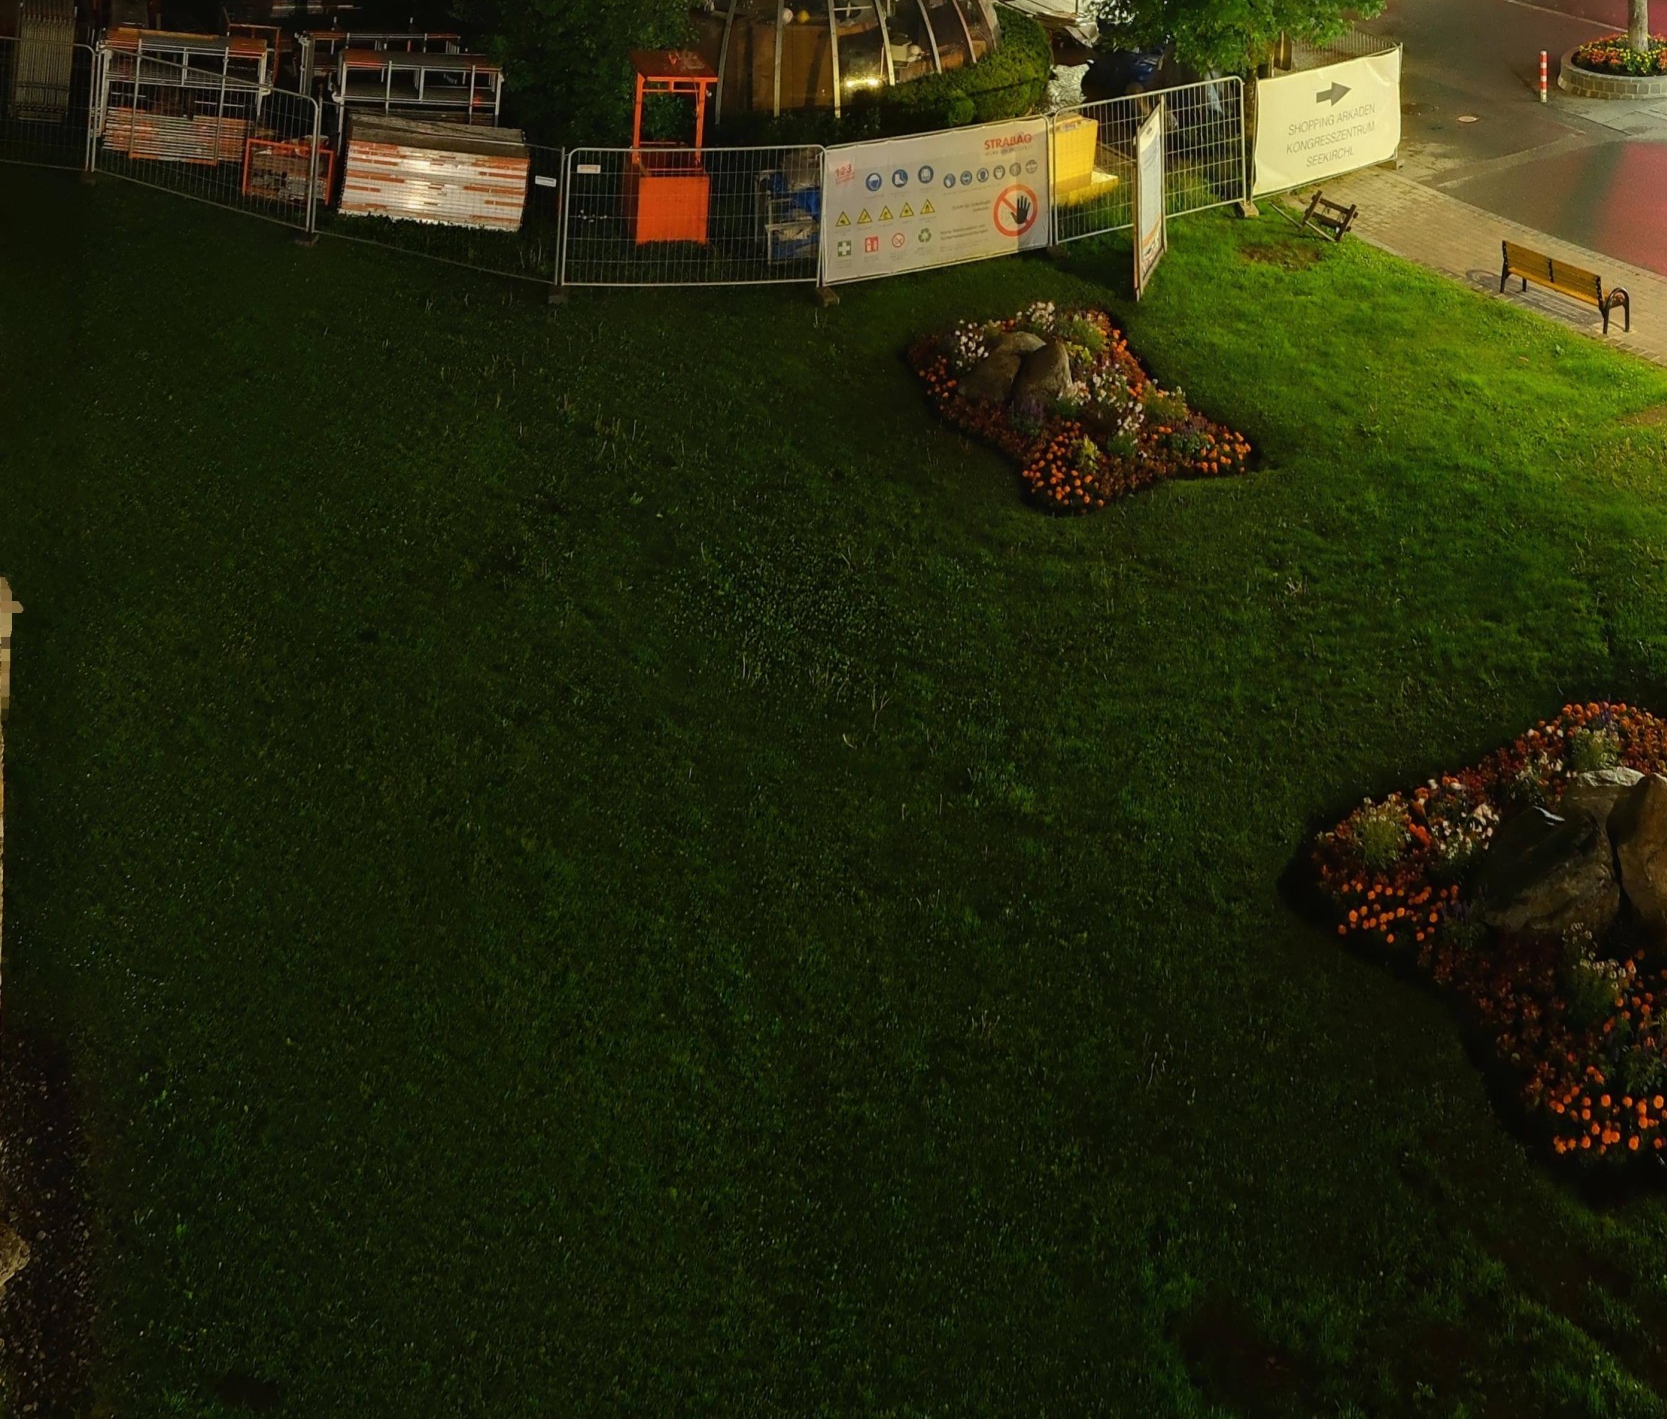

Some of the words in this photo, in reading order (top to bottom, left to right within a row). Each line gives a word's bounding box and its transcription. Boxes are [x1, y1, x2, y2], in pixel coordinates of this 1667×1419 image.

[1288, 115, 1335, 136] SHOPPING
[1336, 103, 1376, 124] ARKADEN
[984, 133, 1032, 150] STRABAG
[1286, 121, 1376, 154] KONGRESSZENTRUM
